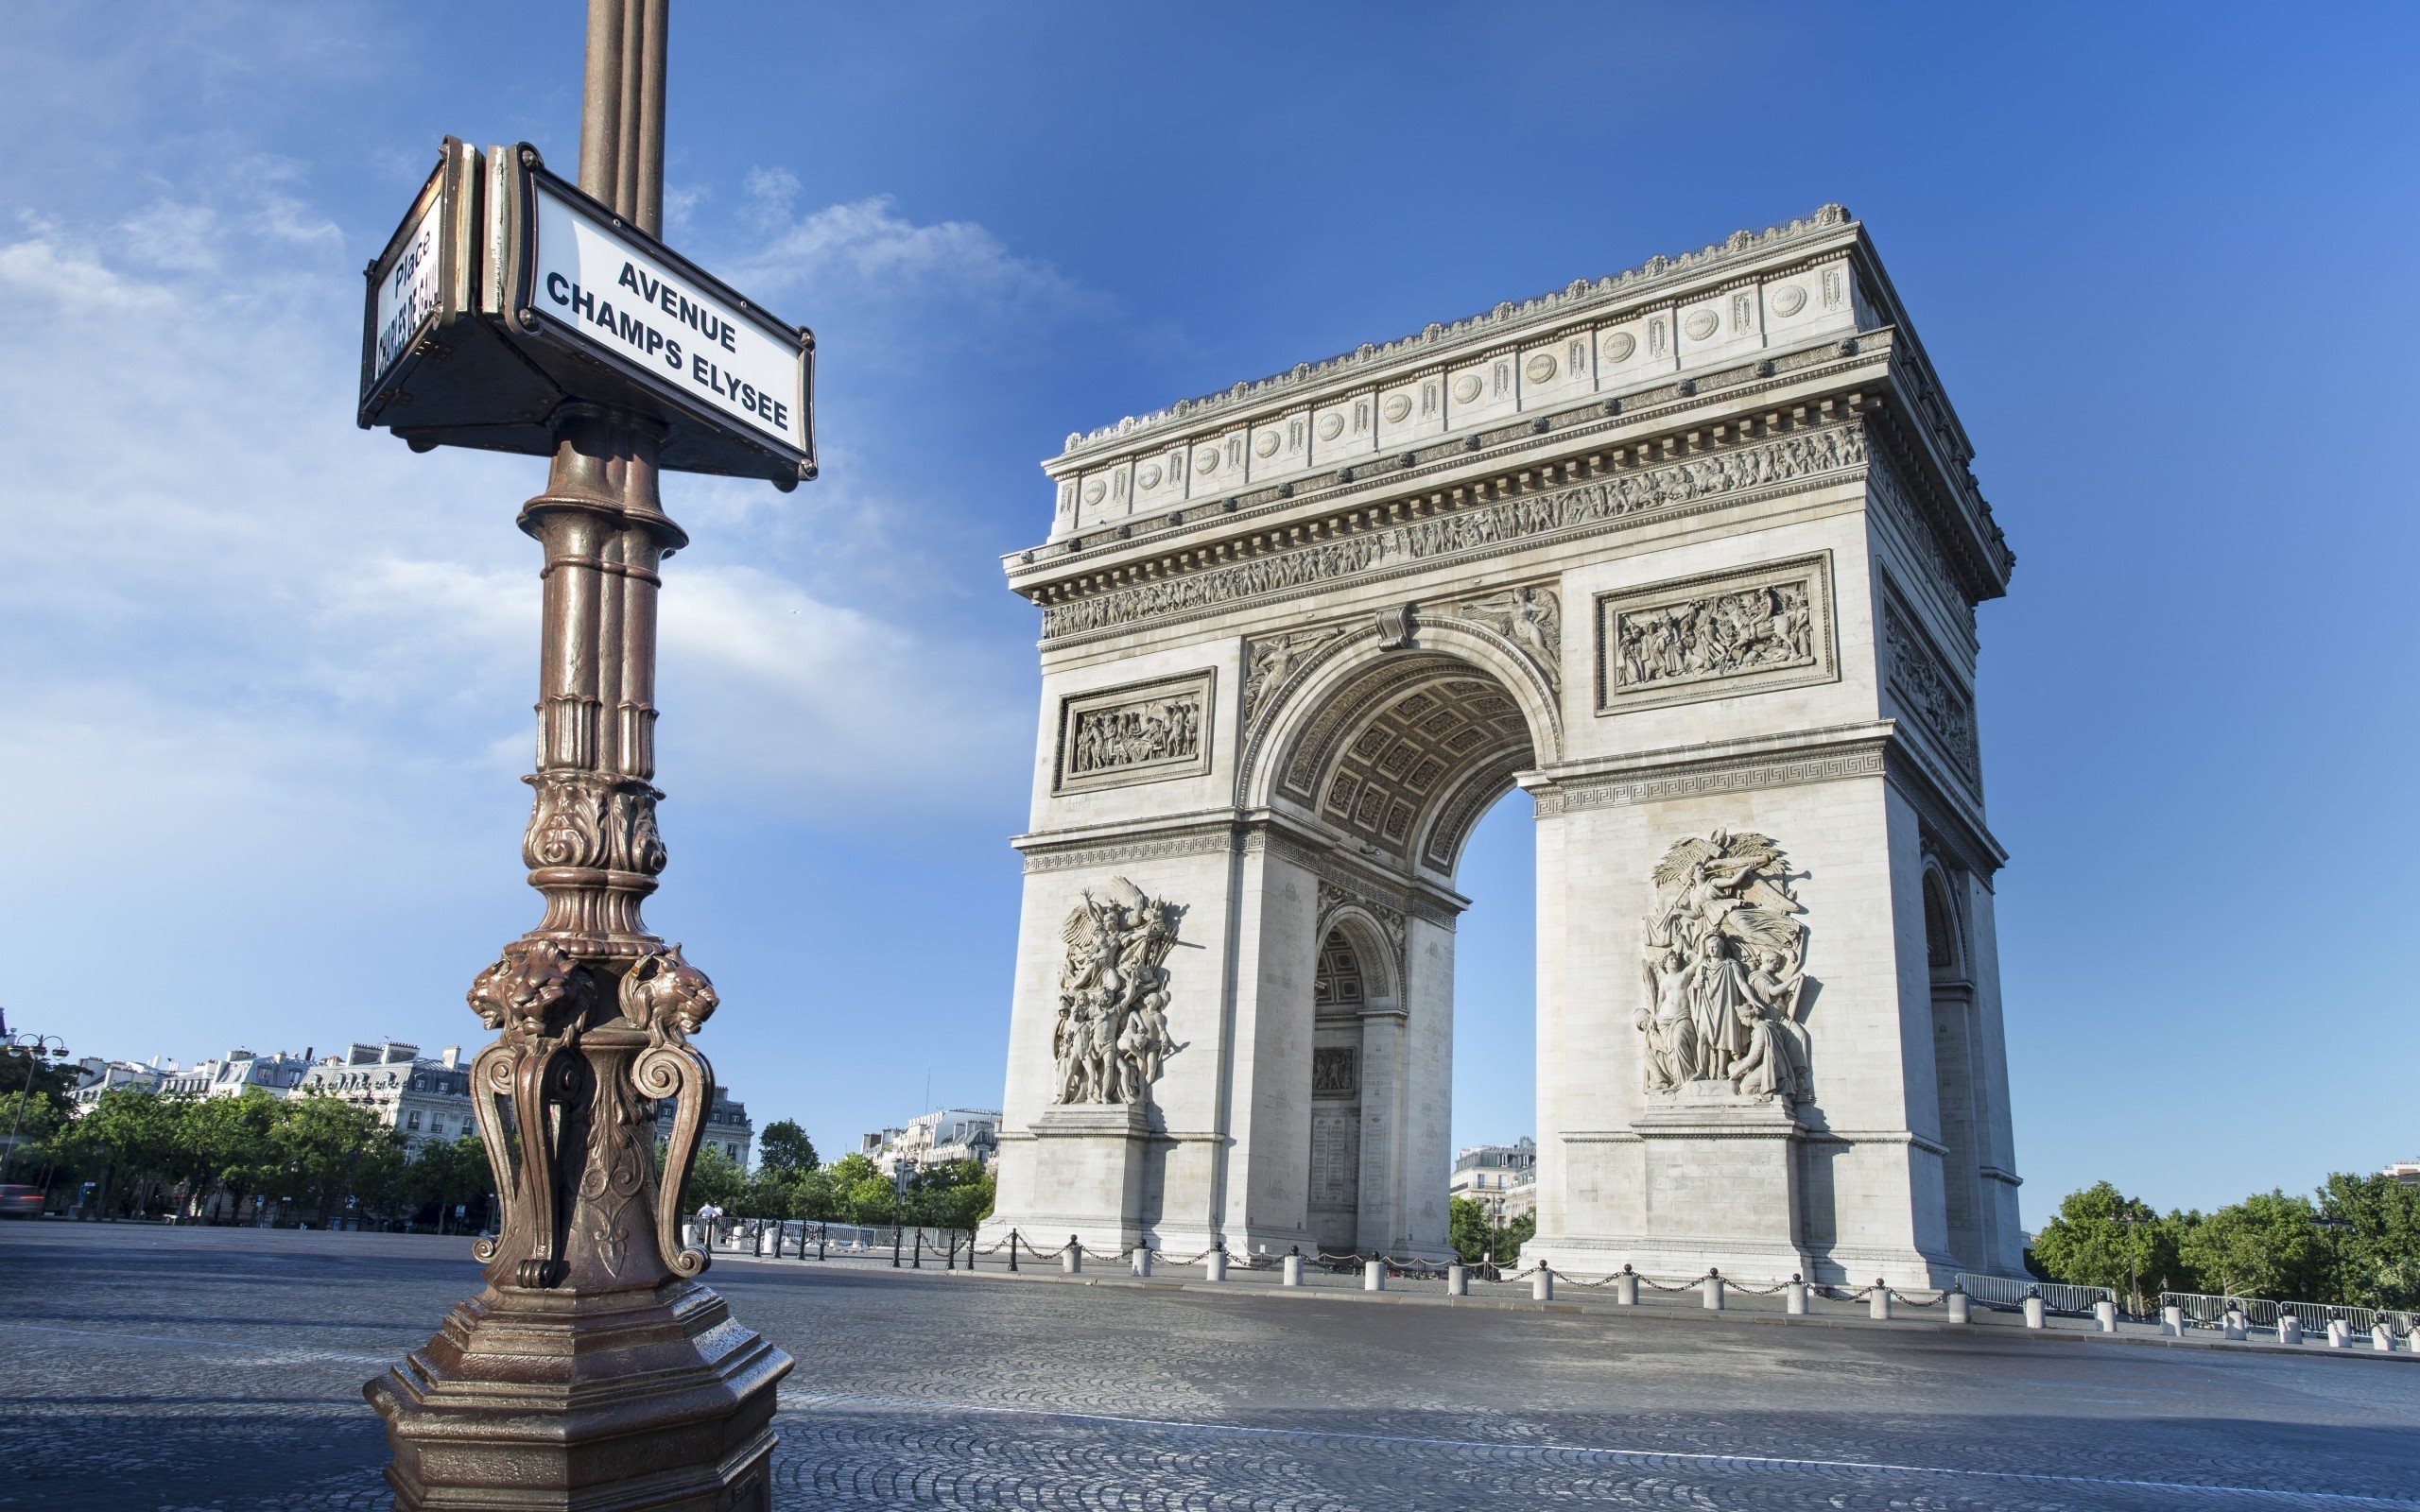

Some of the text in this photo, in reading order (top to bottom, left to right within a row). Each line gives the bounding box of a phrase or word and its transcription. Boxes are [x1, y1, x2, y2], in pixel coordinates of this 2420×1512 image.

[395, 231, 430, 300] Place
[408, 286, 418, 337] DE
[617, 262, 736, 353] AVENUE
[546, 271, 788, 432] CHAMPS ELYSEE
